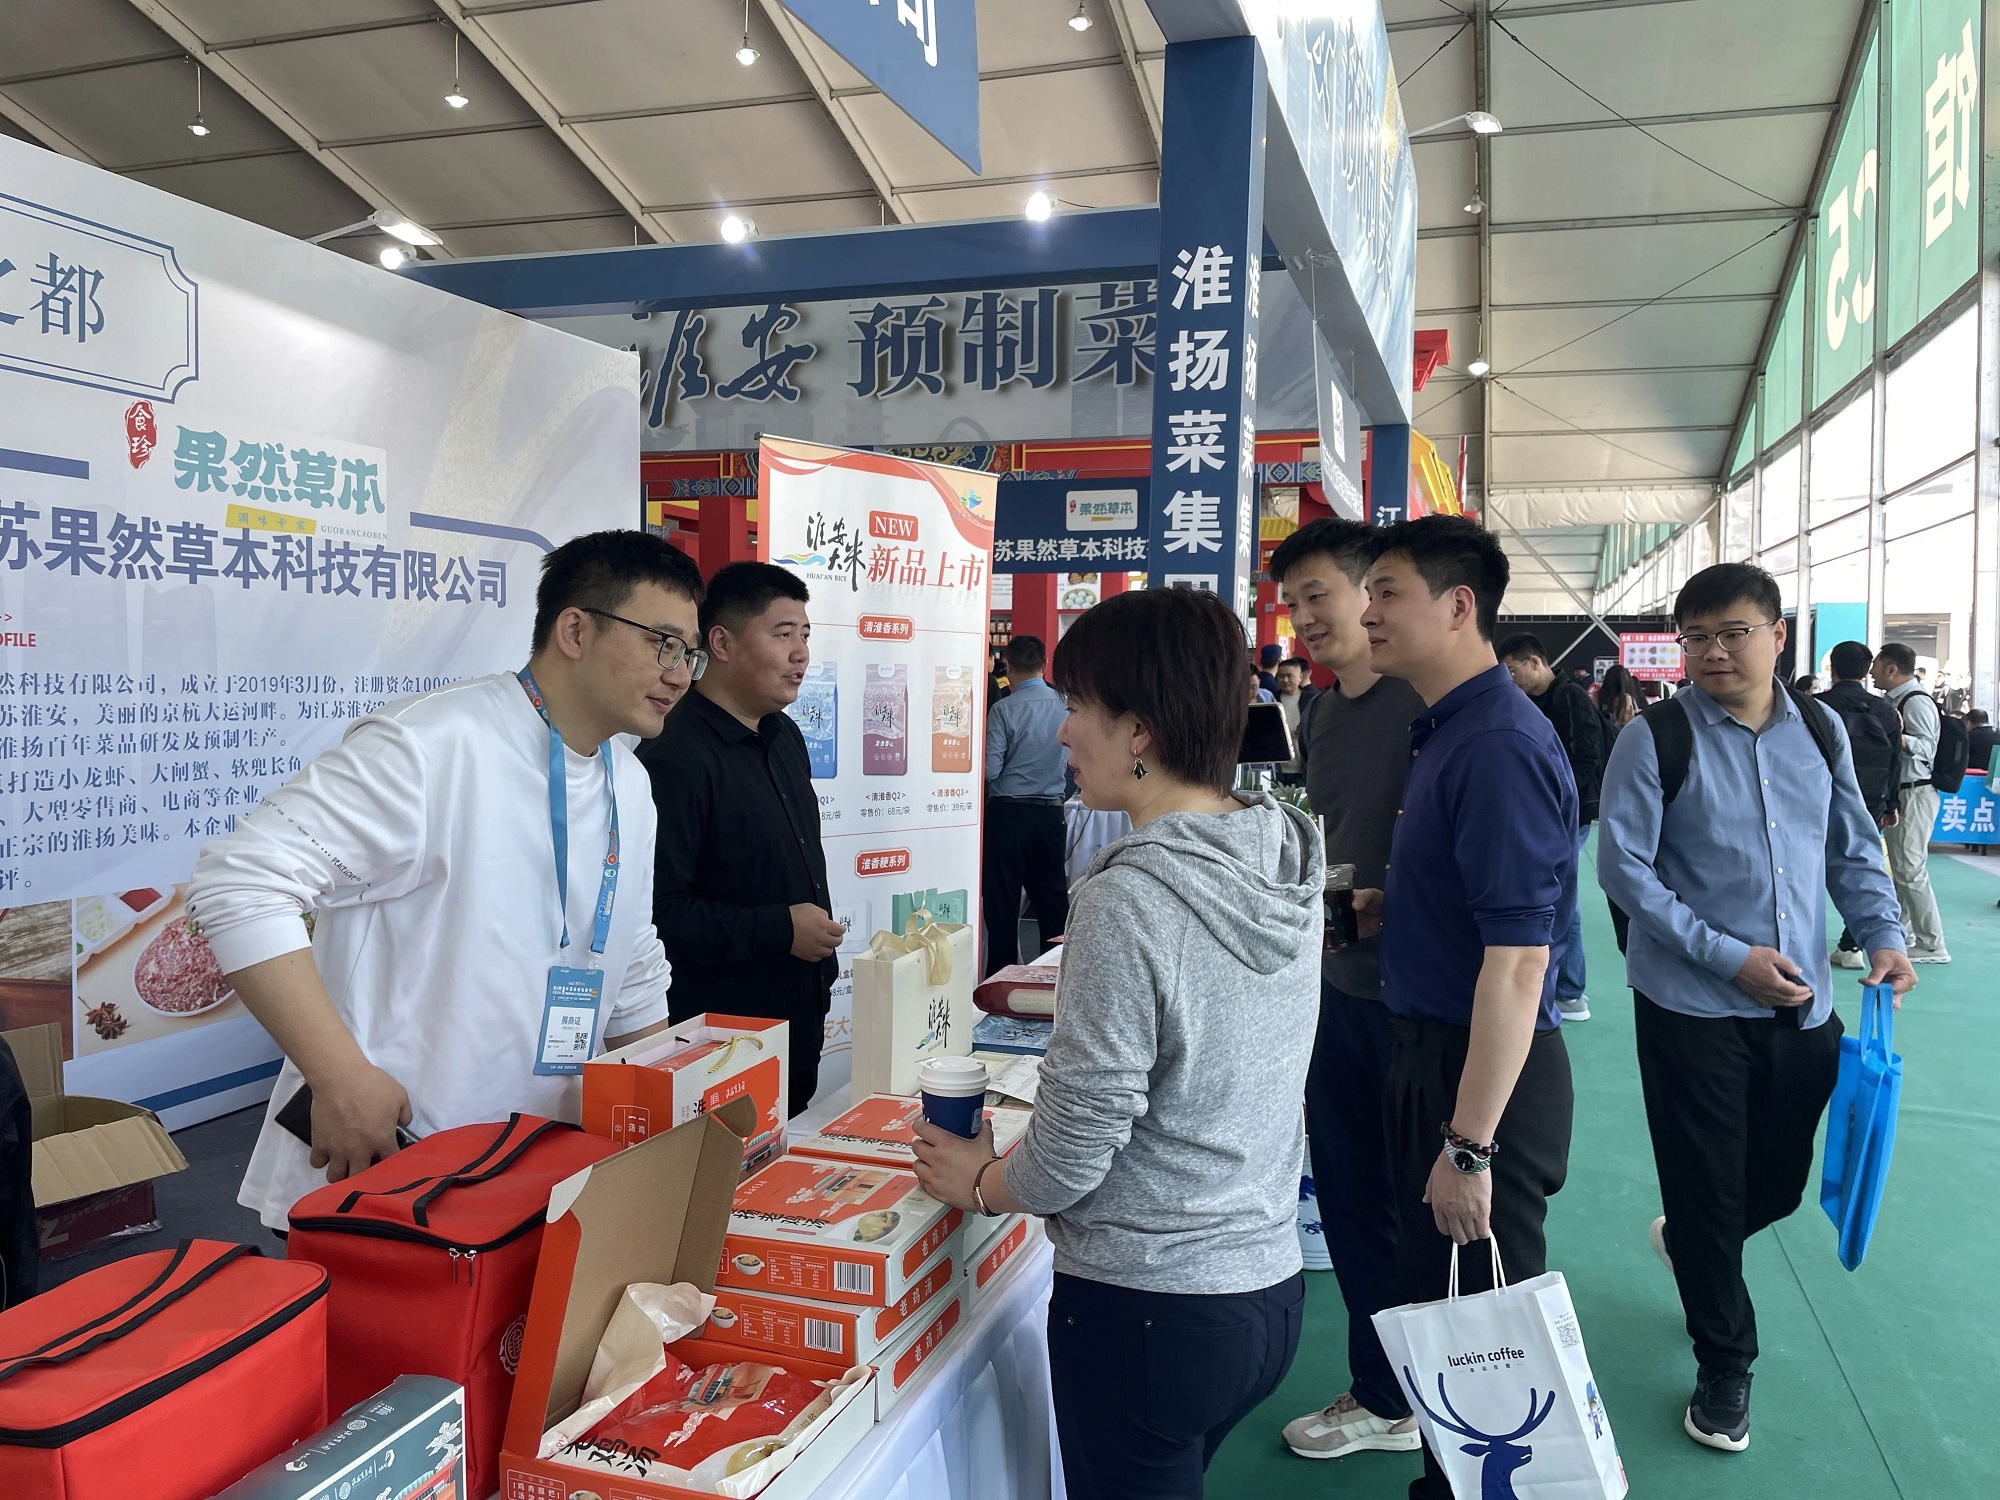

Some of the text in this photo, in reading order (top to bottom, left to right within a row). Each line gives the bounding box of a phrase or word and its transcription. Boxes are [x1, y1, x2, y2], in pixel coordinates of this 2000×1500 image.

[847, 283, 1159, 399] 预制菜
[173, 425, 386, 515] 果然草本
[320, 524, 388, 540] GUORANCAOBEN
[874, 515, 914, 538] NEW
[0, 507, 508, 608] 苏果然草本科技有限公司
[994, 536, 1149, 562] 苏果然草本科技
[867, 543, 985, 592] 新品上市
[819, 810, 841, 821] 8元/袋
[1940, 797, 1995, 833] 卖点
[1447, 1347, 1525, 1367] luckin coffee
